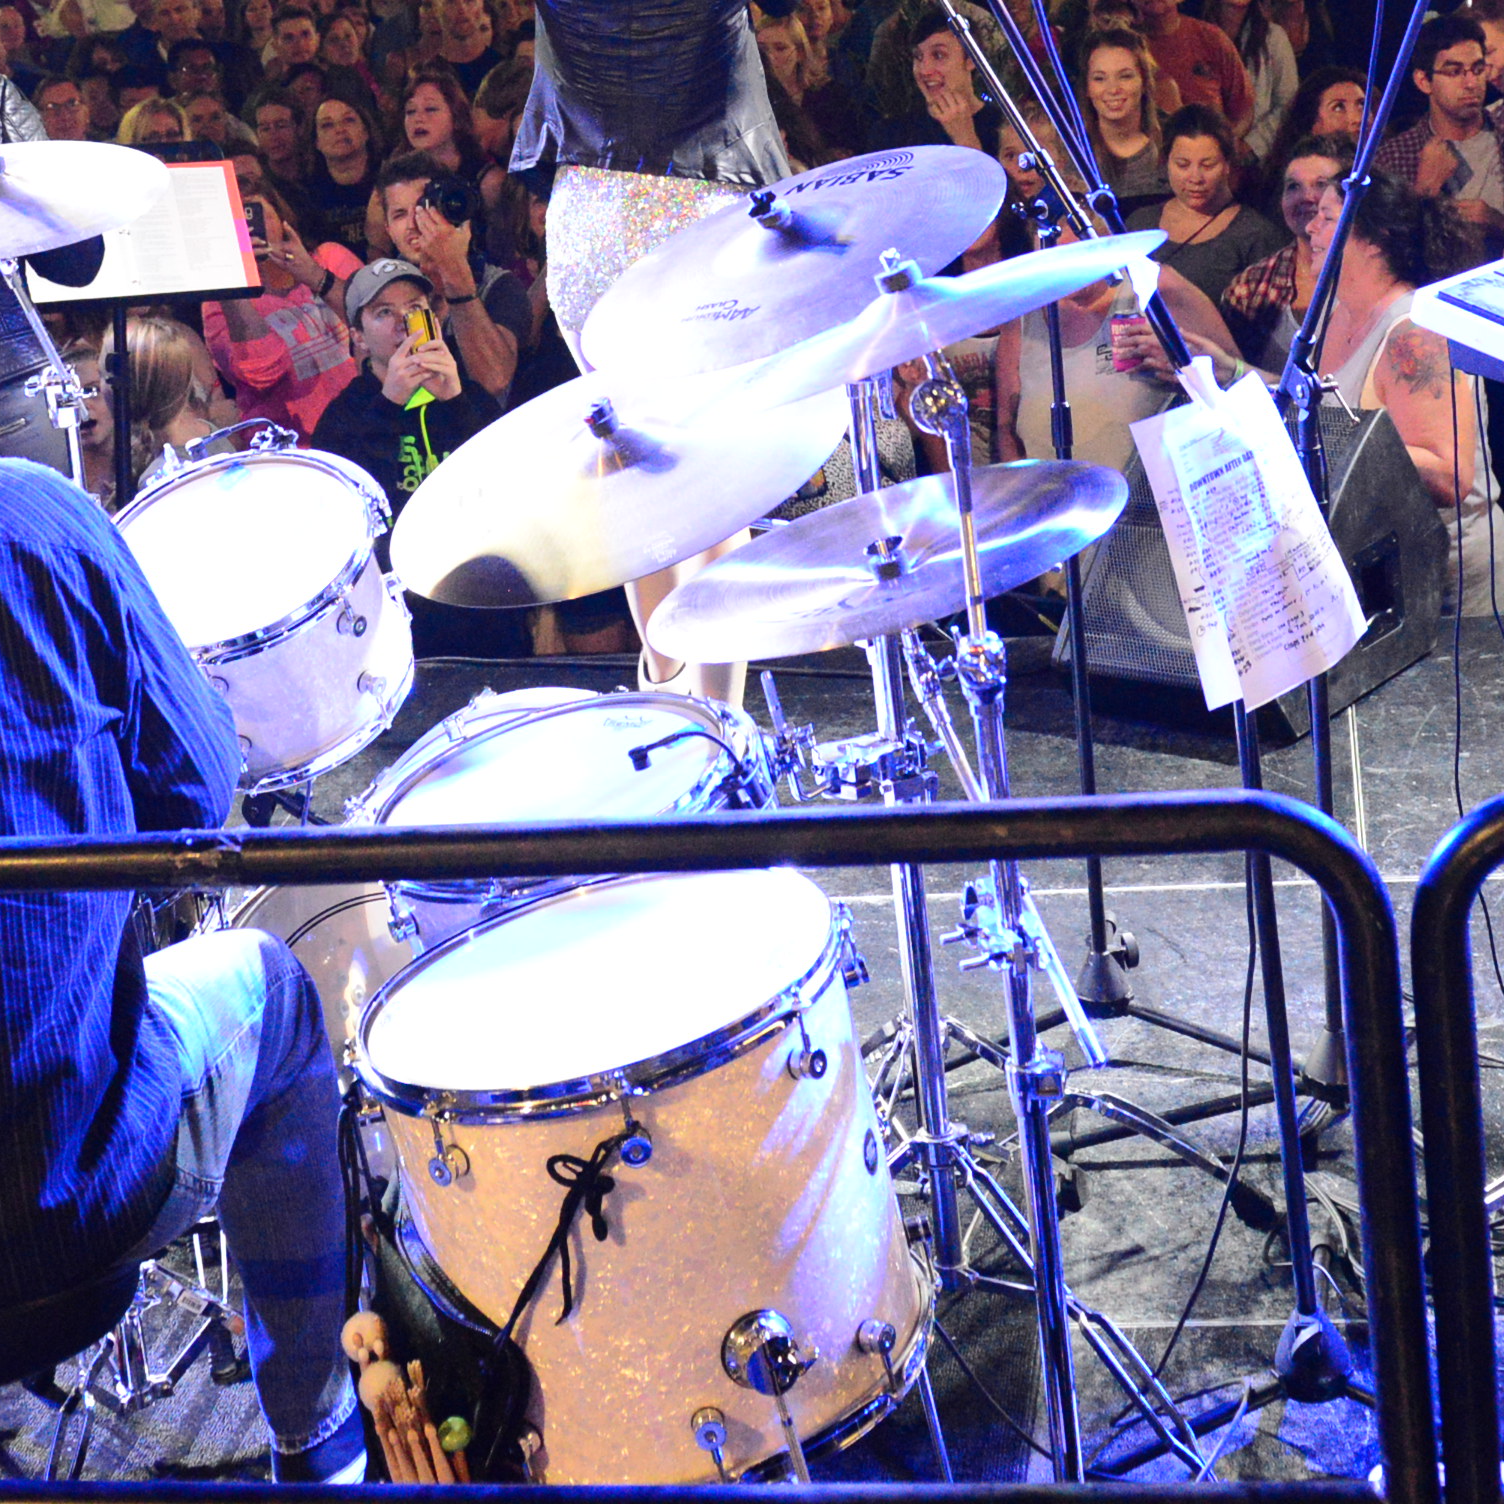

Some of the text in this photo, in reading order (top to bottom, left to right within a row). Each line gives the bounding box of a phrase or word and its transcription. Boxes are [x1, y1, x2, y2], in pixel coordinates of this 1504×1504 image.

[784, 166, 913, 196] SABIAN
[1189, 466, 1224, 492] DOWNTOWN
[1224, 457, 1242, 473] AFTER
